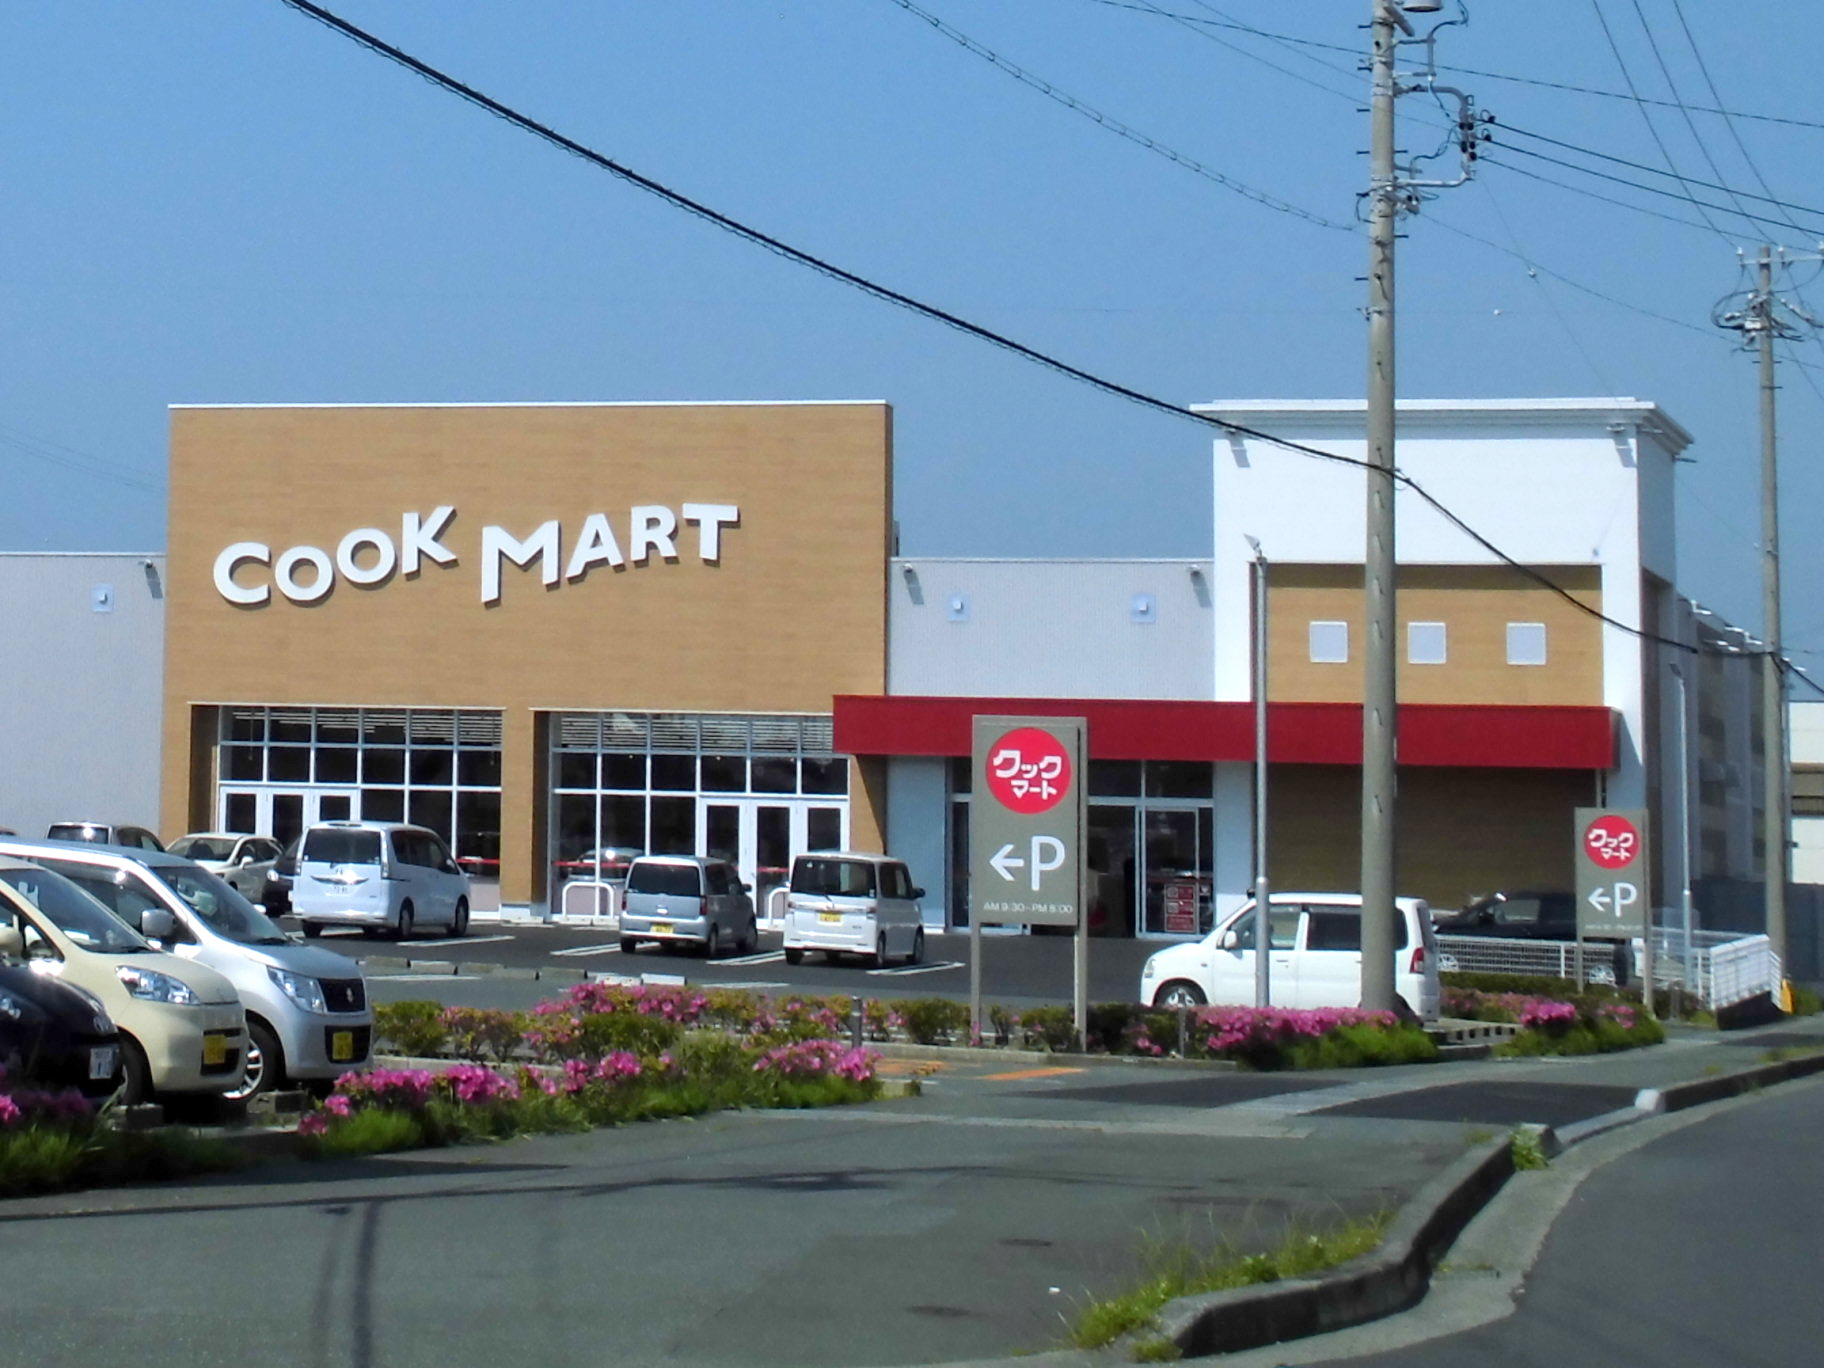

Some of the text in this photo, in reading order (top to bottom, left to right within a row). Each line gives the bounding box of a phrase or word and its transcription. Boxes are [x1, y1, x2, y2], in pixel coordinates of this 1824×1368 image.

[213, 502, 739, 604] COOK MART
[993, 749, 1062, 779] クック
[1011, 779, 1057, 800] マート
[1588, 828, 1634, 848] クック
[1031, 835, 1065, 891] P
[1600, 848, 1631, 860] マート
[1614, 882, 1637, 918] P
